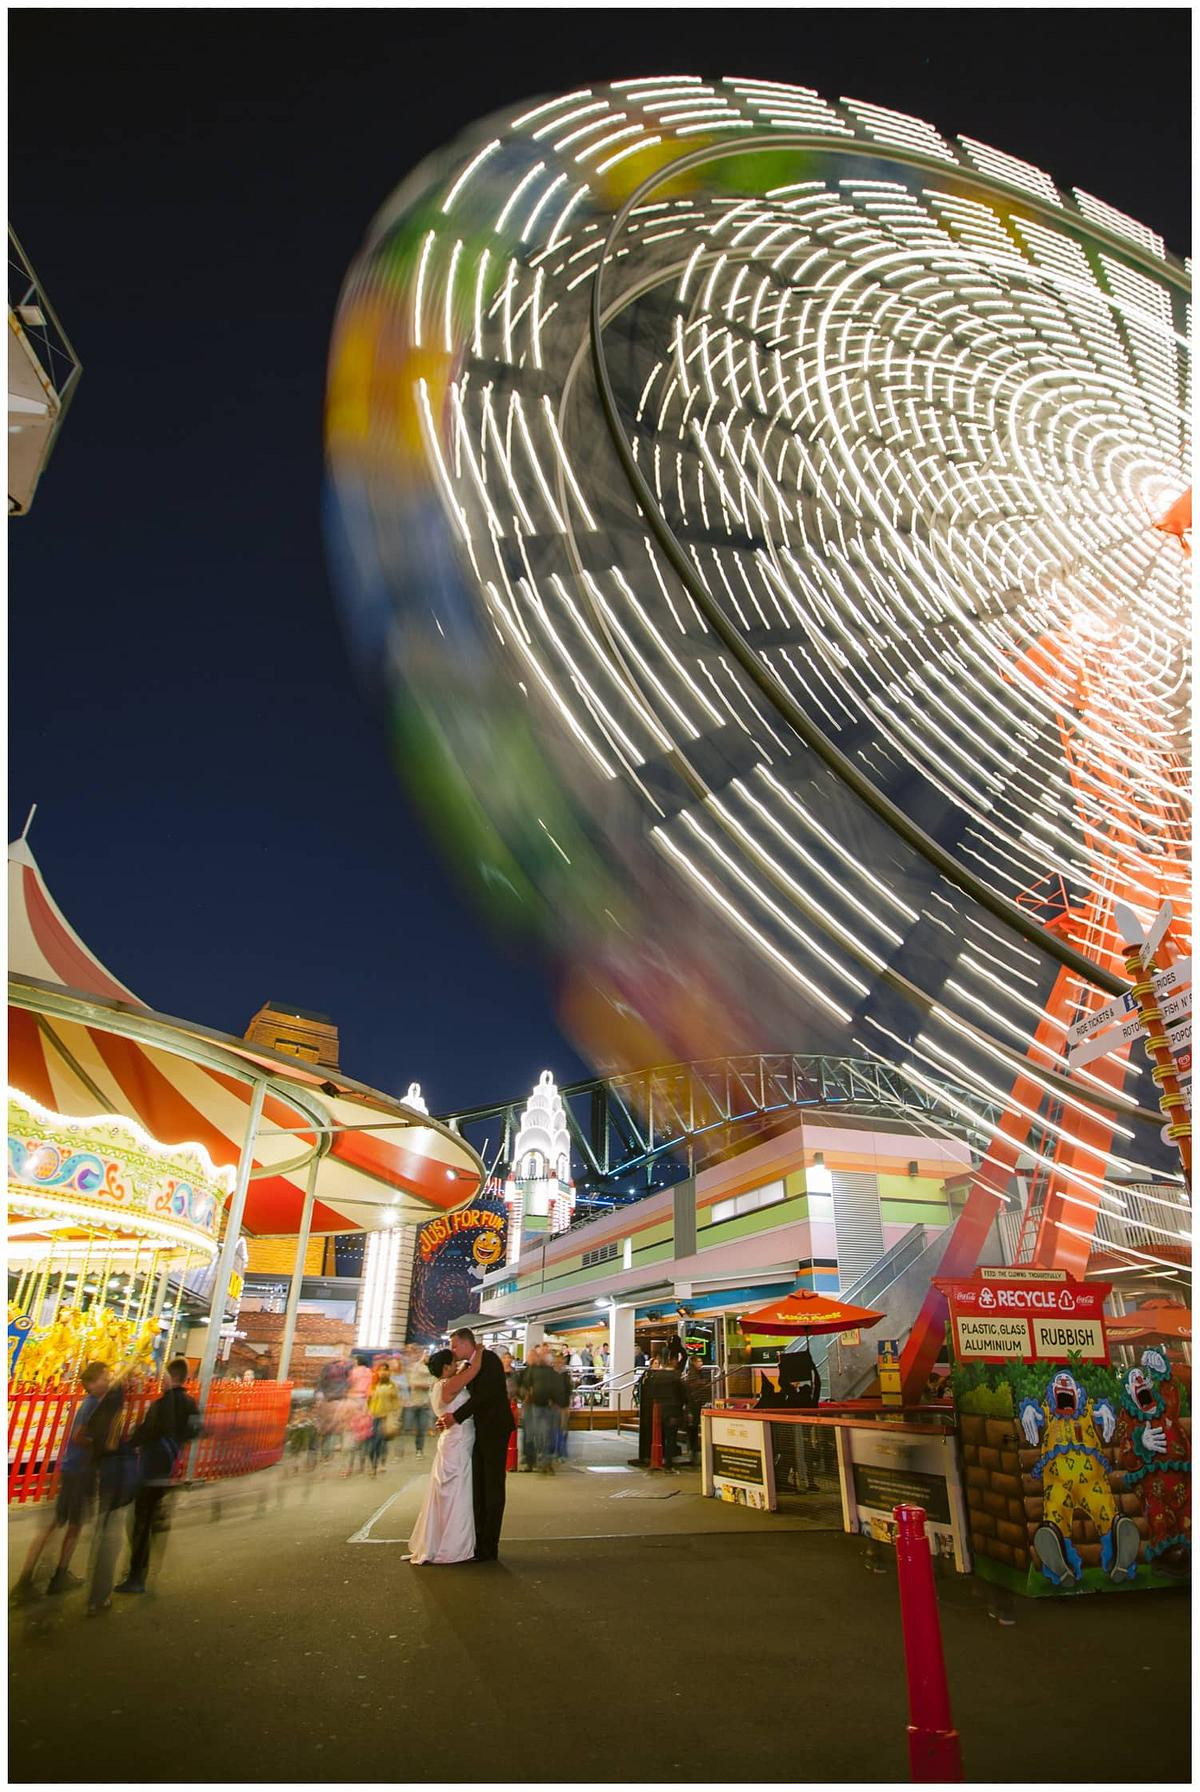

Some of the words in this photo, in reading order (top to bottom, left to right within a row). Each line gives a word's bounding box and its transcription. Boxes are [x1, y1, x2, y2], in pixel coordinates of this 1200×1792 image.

[1156, 972, 1176, 989] RIDES
[1164, 1003, 1180, 1016] FISH
[1076, 1021, 1089, 1036] RIDE
[1088, 1010, 1110, 1031] TICKETS
[420, 1215, 452, 1253] JUST
[454, 1210, 480, 1231] FOR
[481, 1211, 505, 1230] FUN
[997, 1290, 1057, 1307] RECYCLE
[965, 1339, 1022, 1351] ALUMINIUM
[1040, 1328, 1095, 1346] RUBBISH
